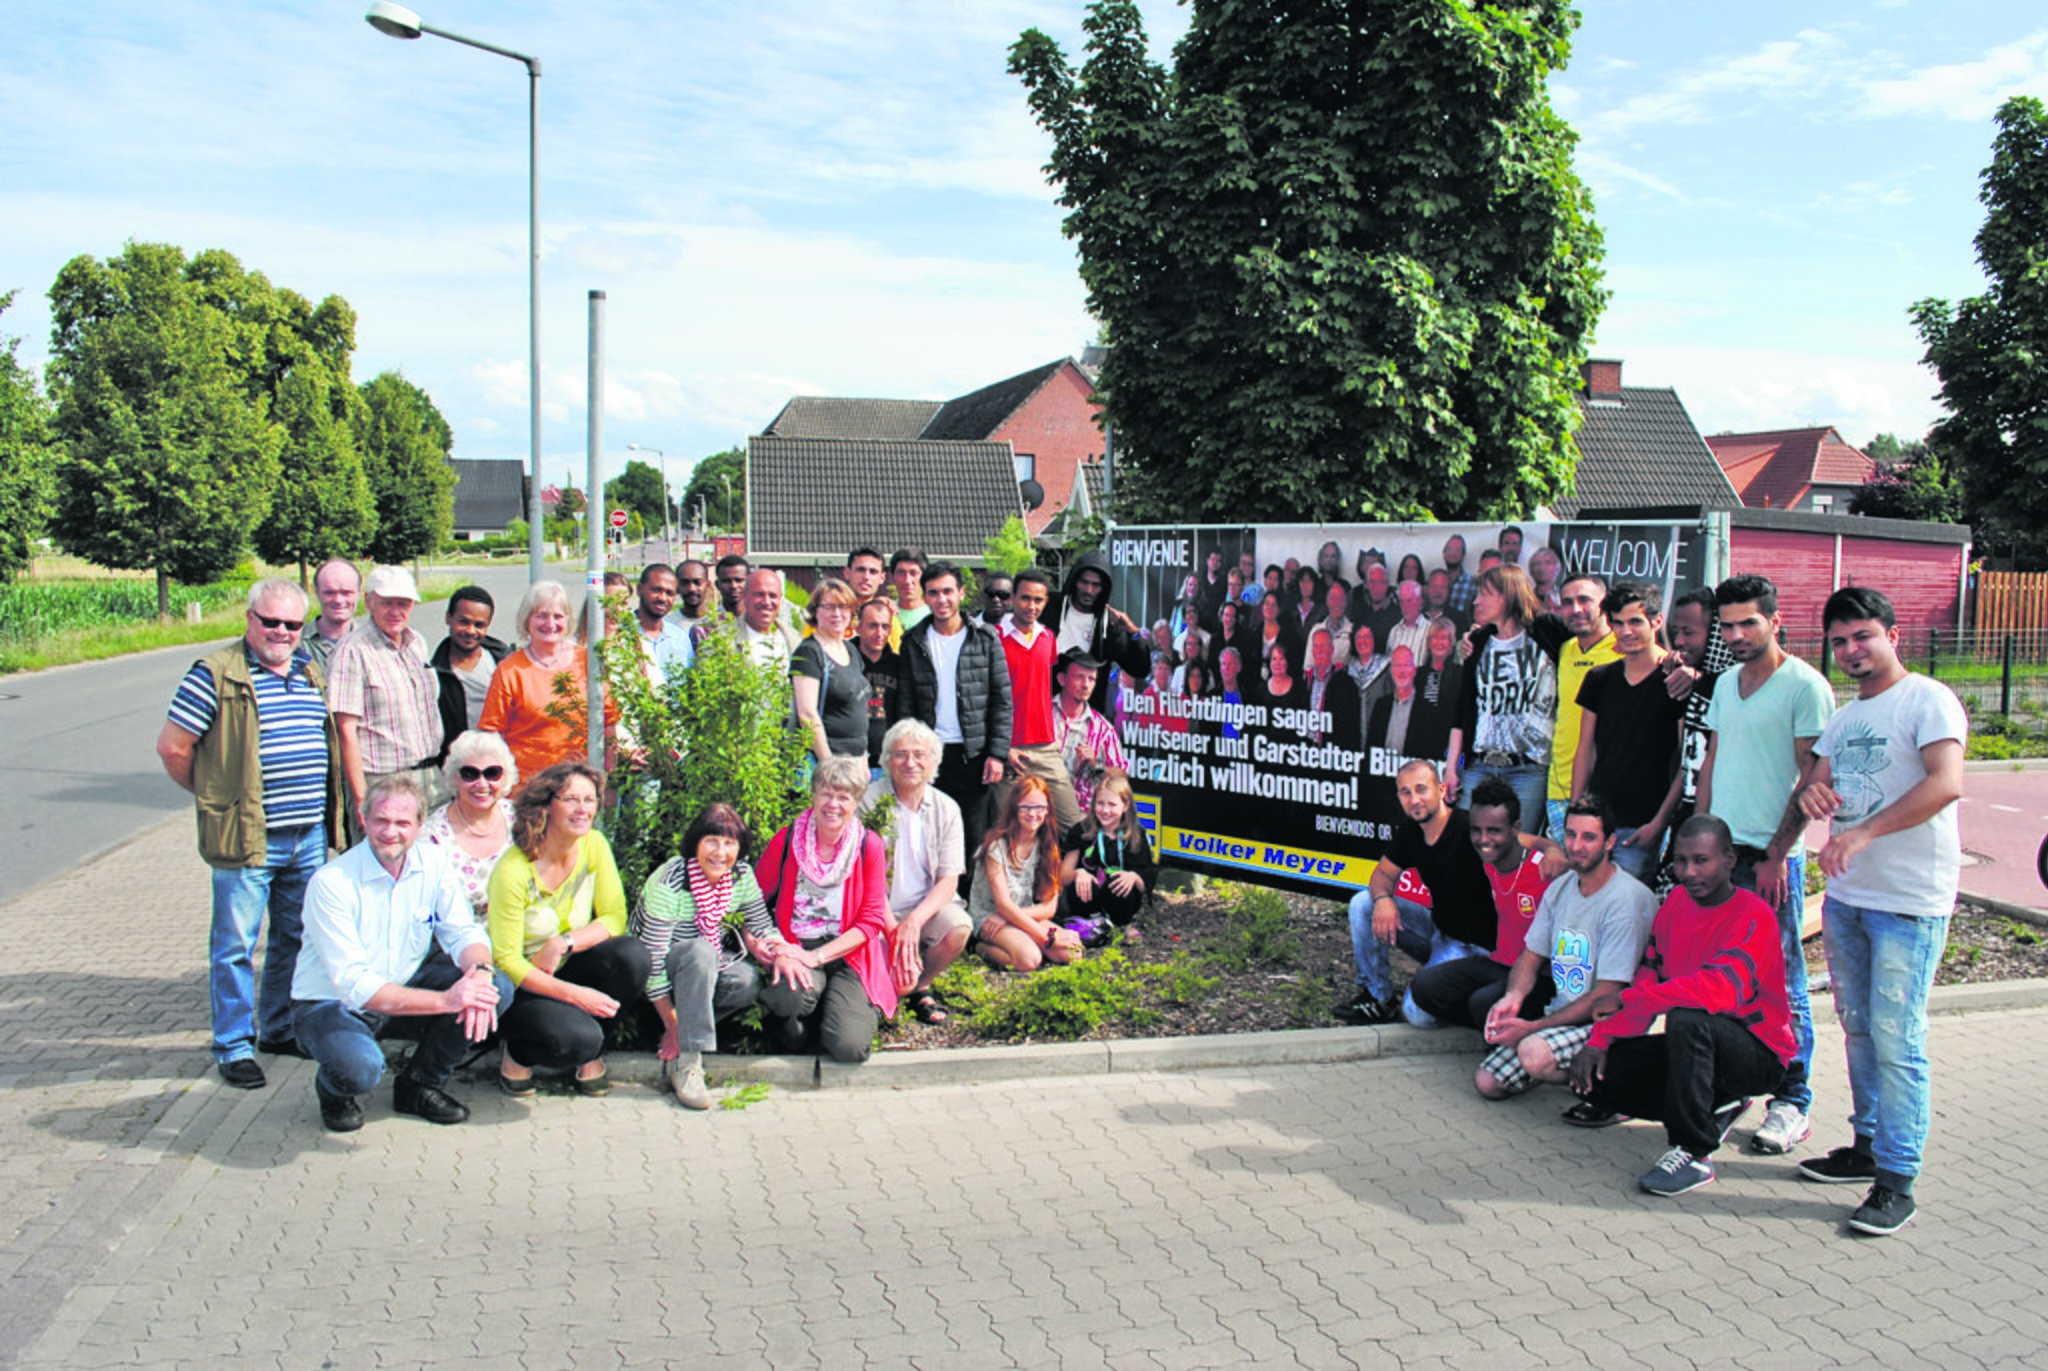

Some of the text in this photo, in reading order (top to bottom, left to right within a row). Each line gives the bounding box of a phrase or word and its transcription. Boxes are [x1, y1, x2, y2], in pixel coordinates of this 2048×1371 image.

[1112, 539, 1189, 567] BIENVENUE
[1561, 538, 1689, 579] WELCOME
[1122, 688, 1334, 738] Den Flüchtlingen sagen
[1121, 719, 1211, 755] Wulfsener
[1214, 733, 1250, 761] und
[1253, 734, 1365, 773] Garstedter
[1123, 749, 1359, 811] Herzlich willkommen!
[1178, 831, 1346, 876] Volker Meyer
